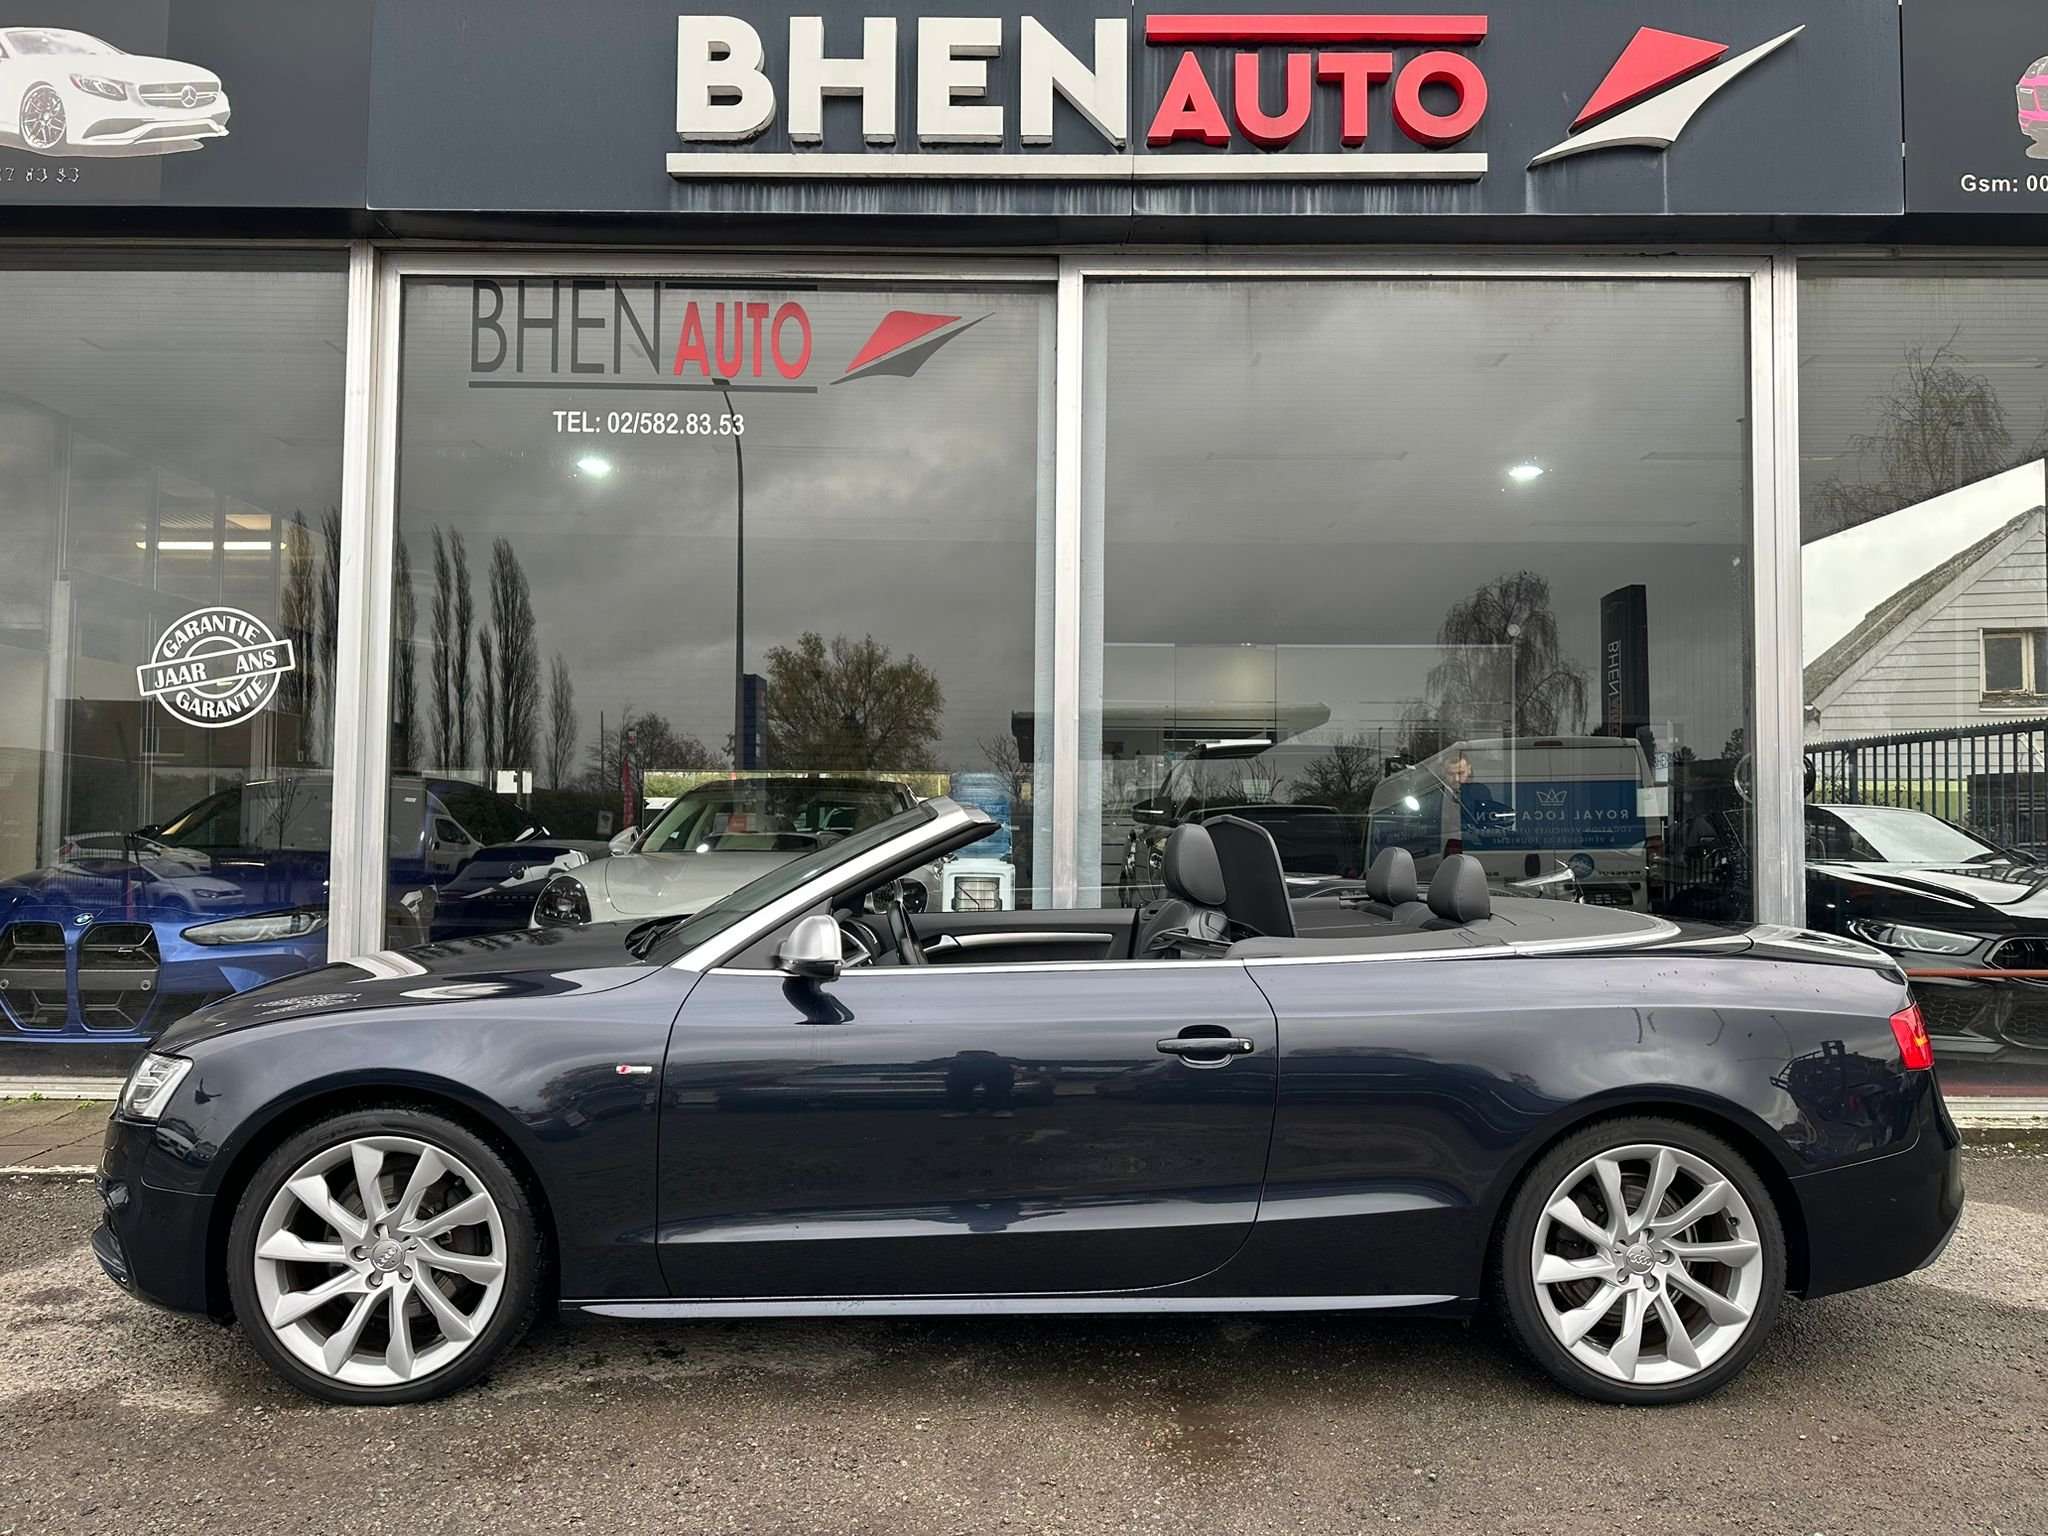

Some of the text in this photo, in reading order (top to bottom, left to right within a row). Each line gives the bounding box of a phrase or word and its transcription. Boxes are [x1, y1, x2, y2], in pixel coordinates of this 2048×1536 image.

[675, 15, 1489, 146] BHEN AUTO
[1960, 174, 2018, 193] Gsm:
[470, 279, 812, 379] BHEN AUTO
[553, 411, 745, 436] TEL: 02/582.83.53
[162, 614, 260, 658] GARANTIE
[154, 649, 277, 689] JAAR ANS
[176, 675, 267, 719] GARANTIE
